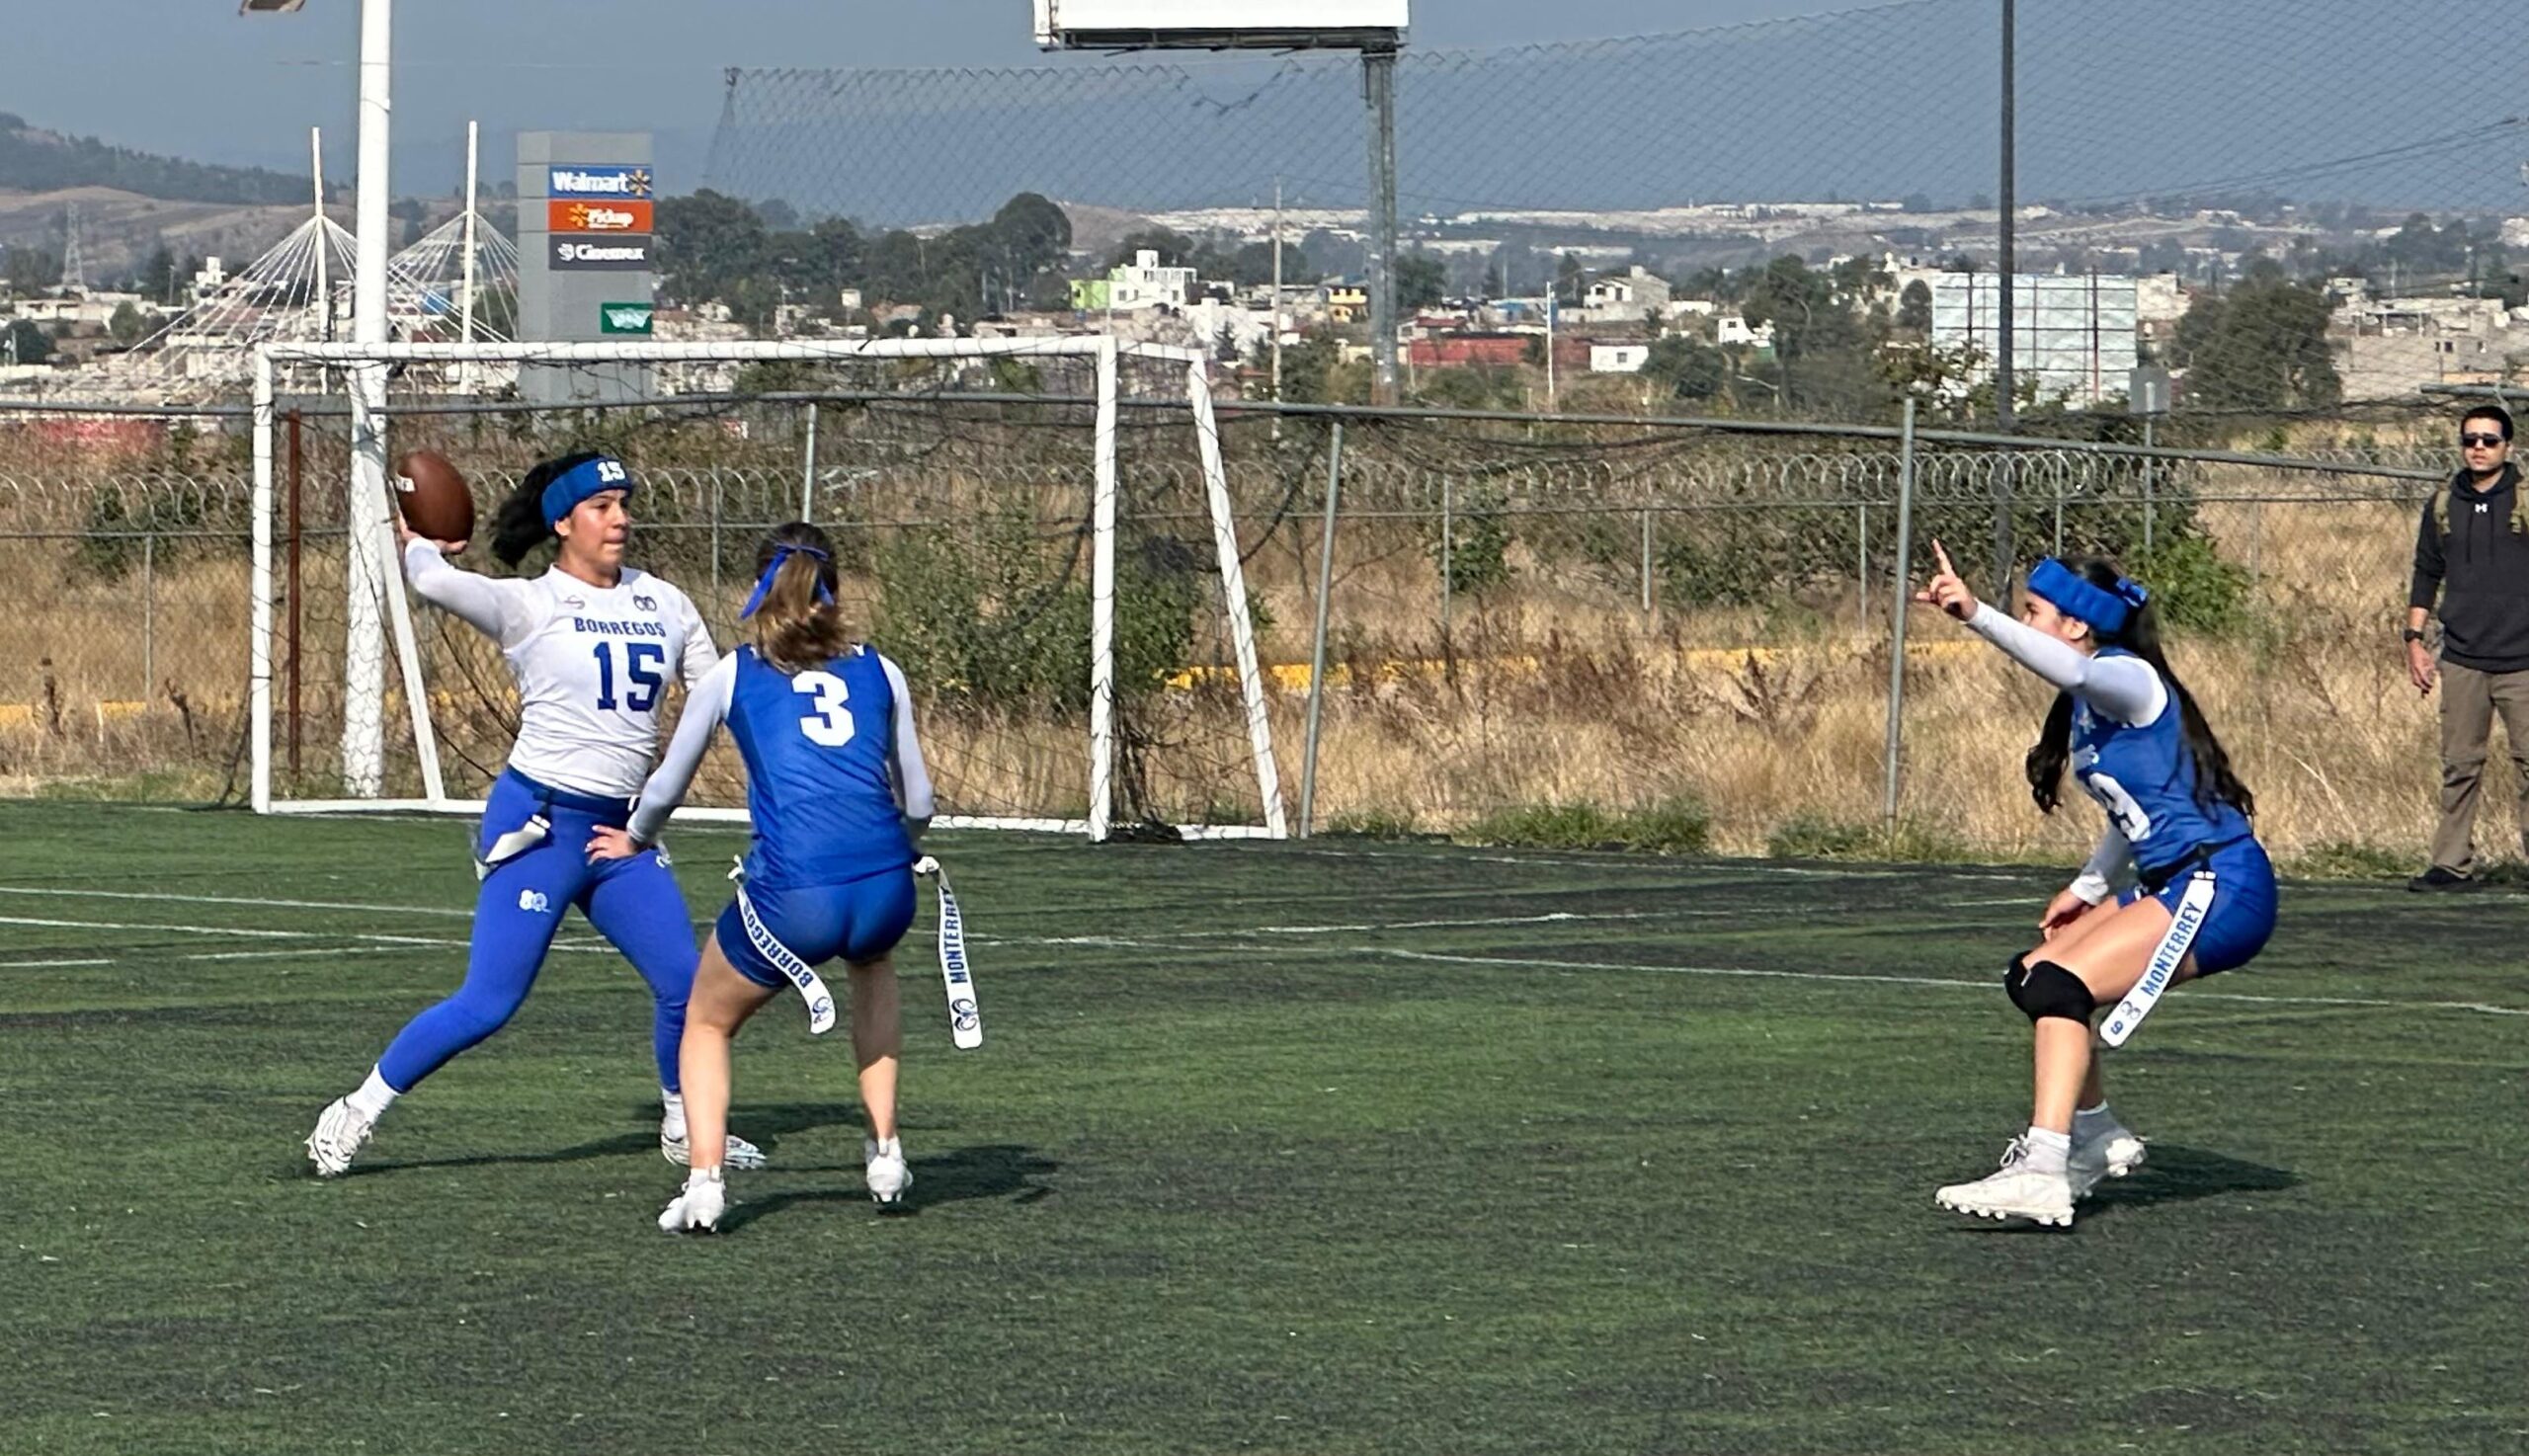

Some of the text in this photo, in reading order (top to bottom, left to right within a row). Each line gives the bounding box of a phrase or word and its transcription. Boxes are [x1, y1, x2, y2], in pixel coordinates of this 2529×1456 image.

[552, 172, 629, 193] Walmart
[598, 460, 625, 482] 15
[574, 617, 667, 638] BORREGOS
[594, 642, 665, 712] 15
[791, 670, 856, 747] 3
[2139, 901, 2203, 998] MONTERREY
